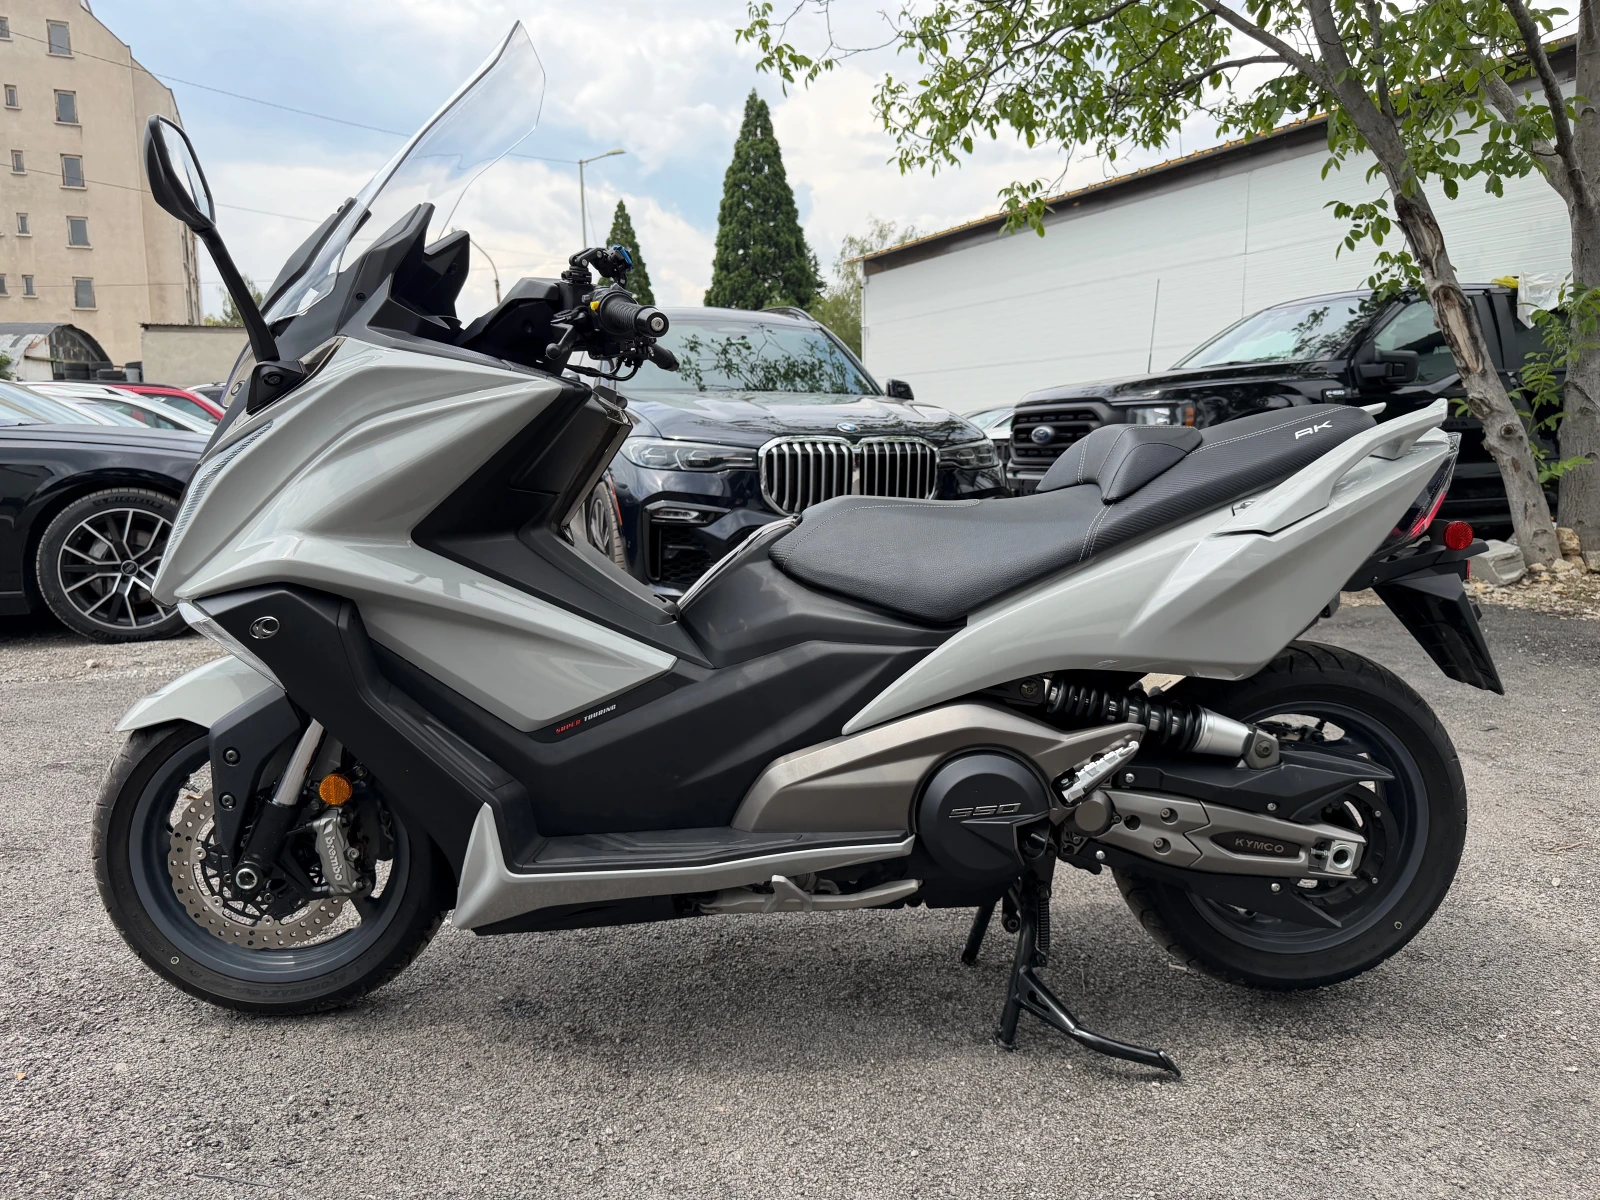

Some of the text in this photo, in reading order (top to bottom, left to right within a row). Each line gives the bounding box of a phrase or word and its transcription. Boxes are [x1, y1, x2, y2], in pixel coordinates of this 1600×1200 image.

[1295, 420, 1333, 440] AK
[555, 704, 617, 733] SUPER TOURING
[948, 802, 1022, 819] 550
[1234, 838, 1285, 853] KYMCO
[324, 835, 343, 881] brembo
